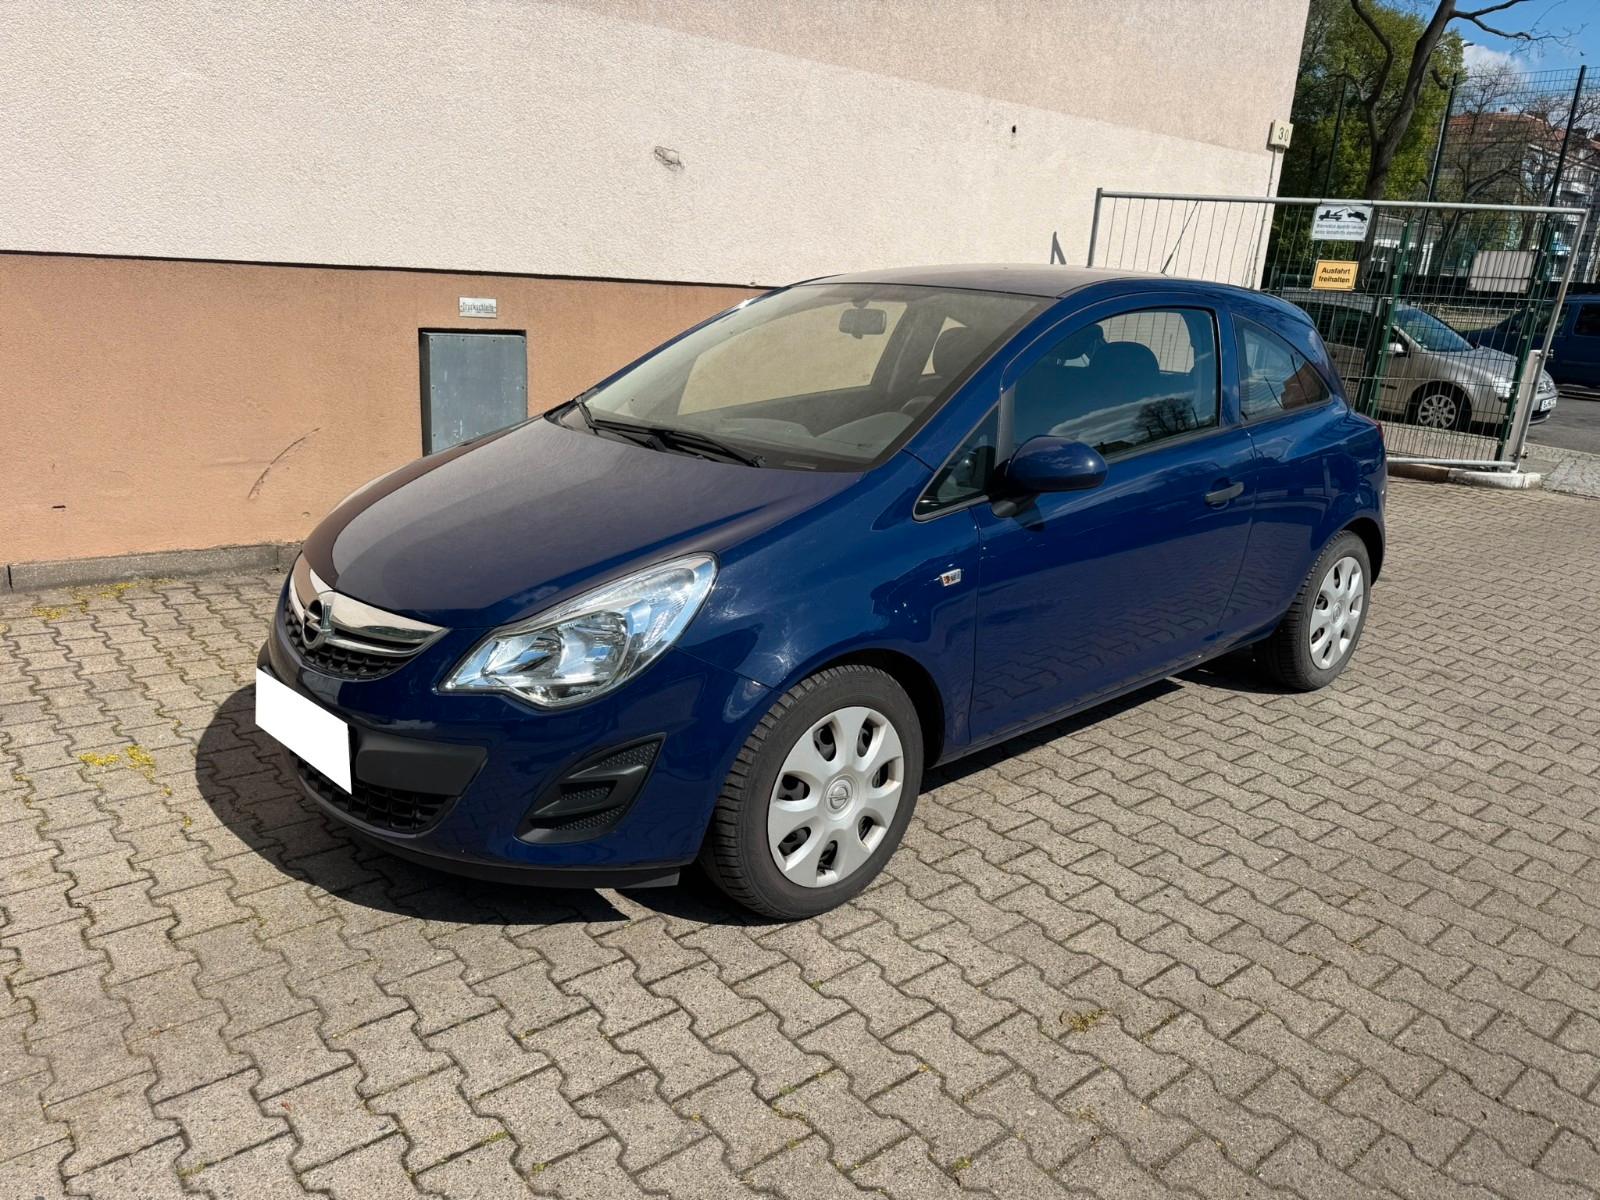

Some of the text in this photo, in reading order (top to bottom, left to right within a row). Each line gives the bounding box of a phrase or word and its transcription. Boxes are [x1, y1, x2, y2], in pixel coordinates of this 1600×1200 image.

[1278, 126, 1290, 142] 30
[1321, 266, 1351, 275] Ausfahrt
[1318, 275, 1350, 283] freihalten
